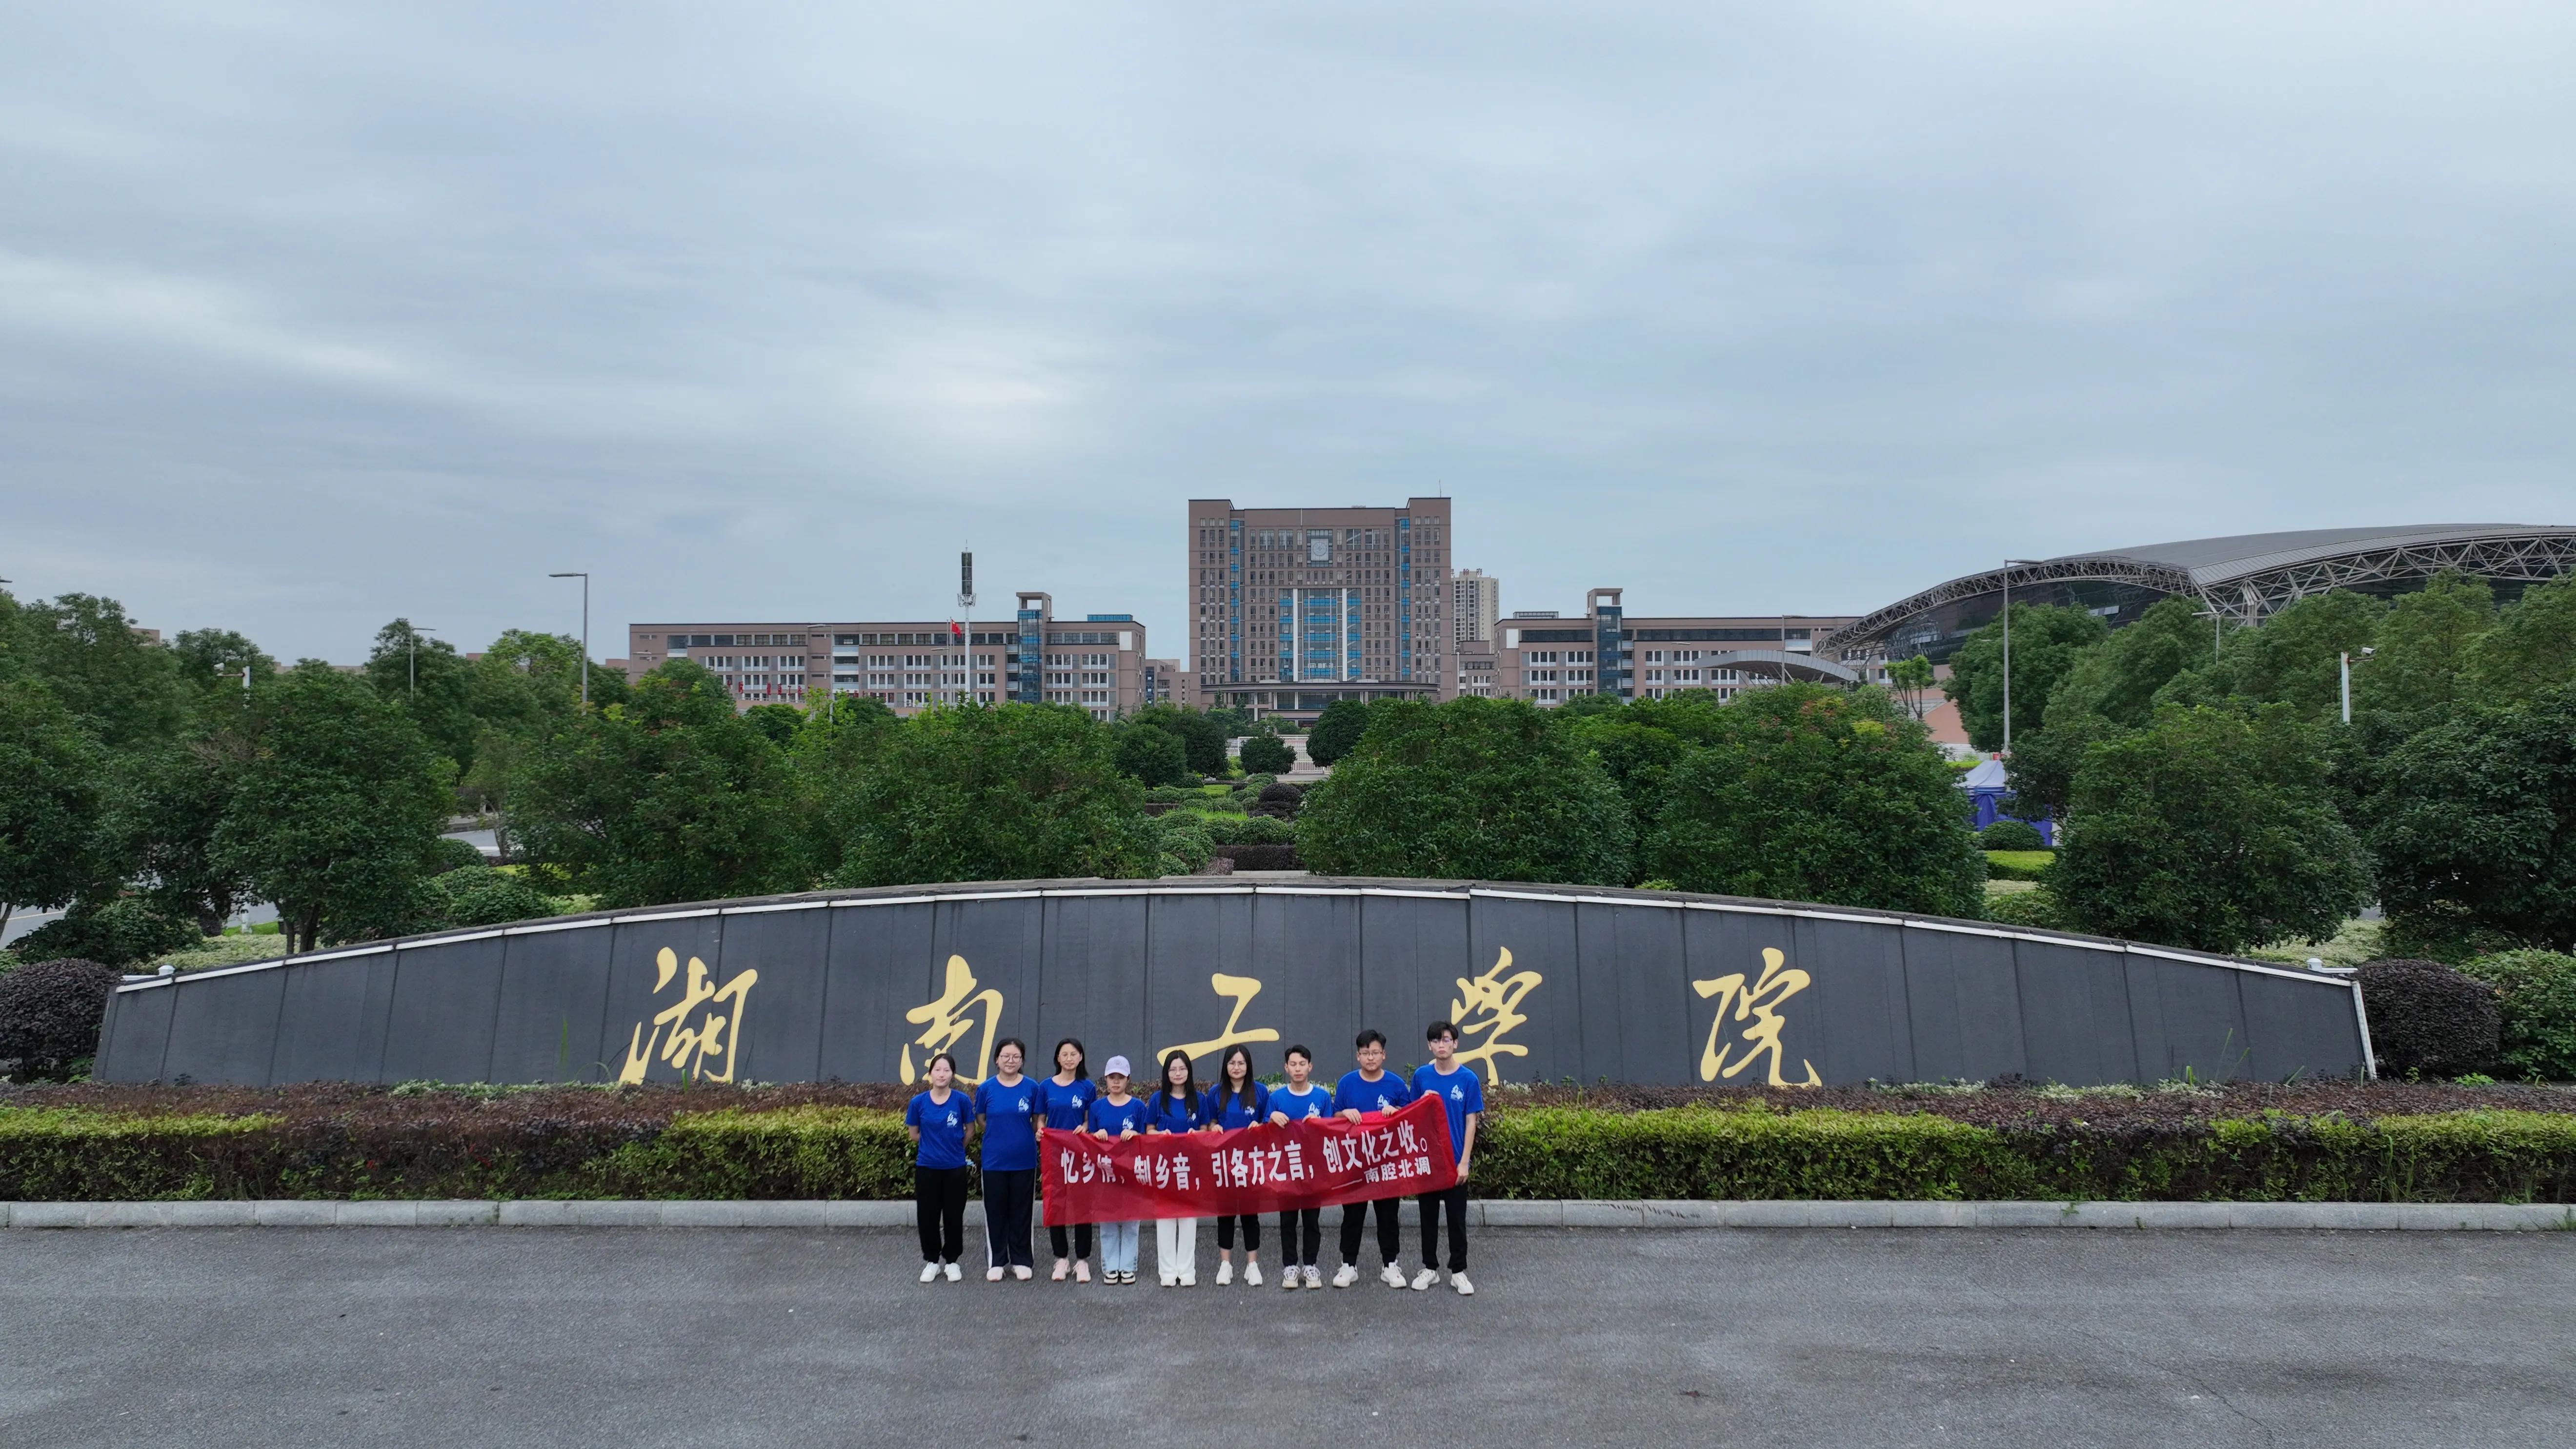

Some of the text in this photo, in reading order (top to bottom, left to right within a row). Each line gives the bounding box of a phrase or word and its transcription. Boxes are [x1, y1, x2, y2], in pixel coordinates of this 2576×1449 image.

[618, 946, 1822, 1087] 湖南工学院
